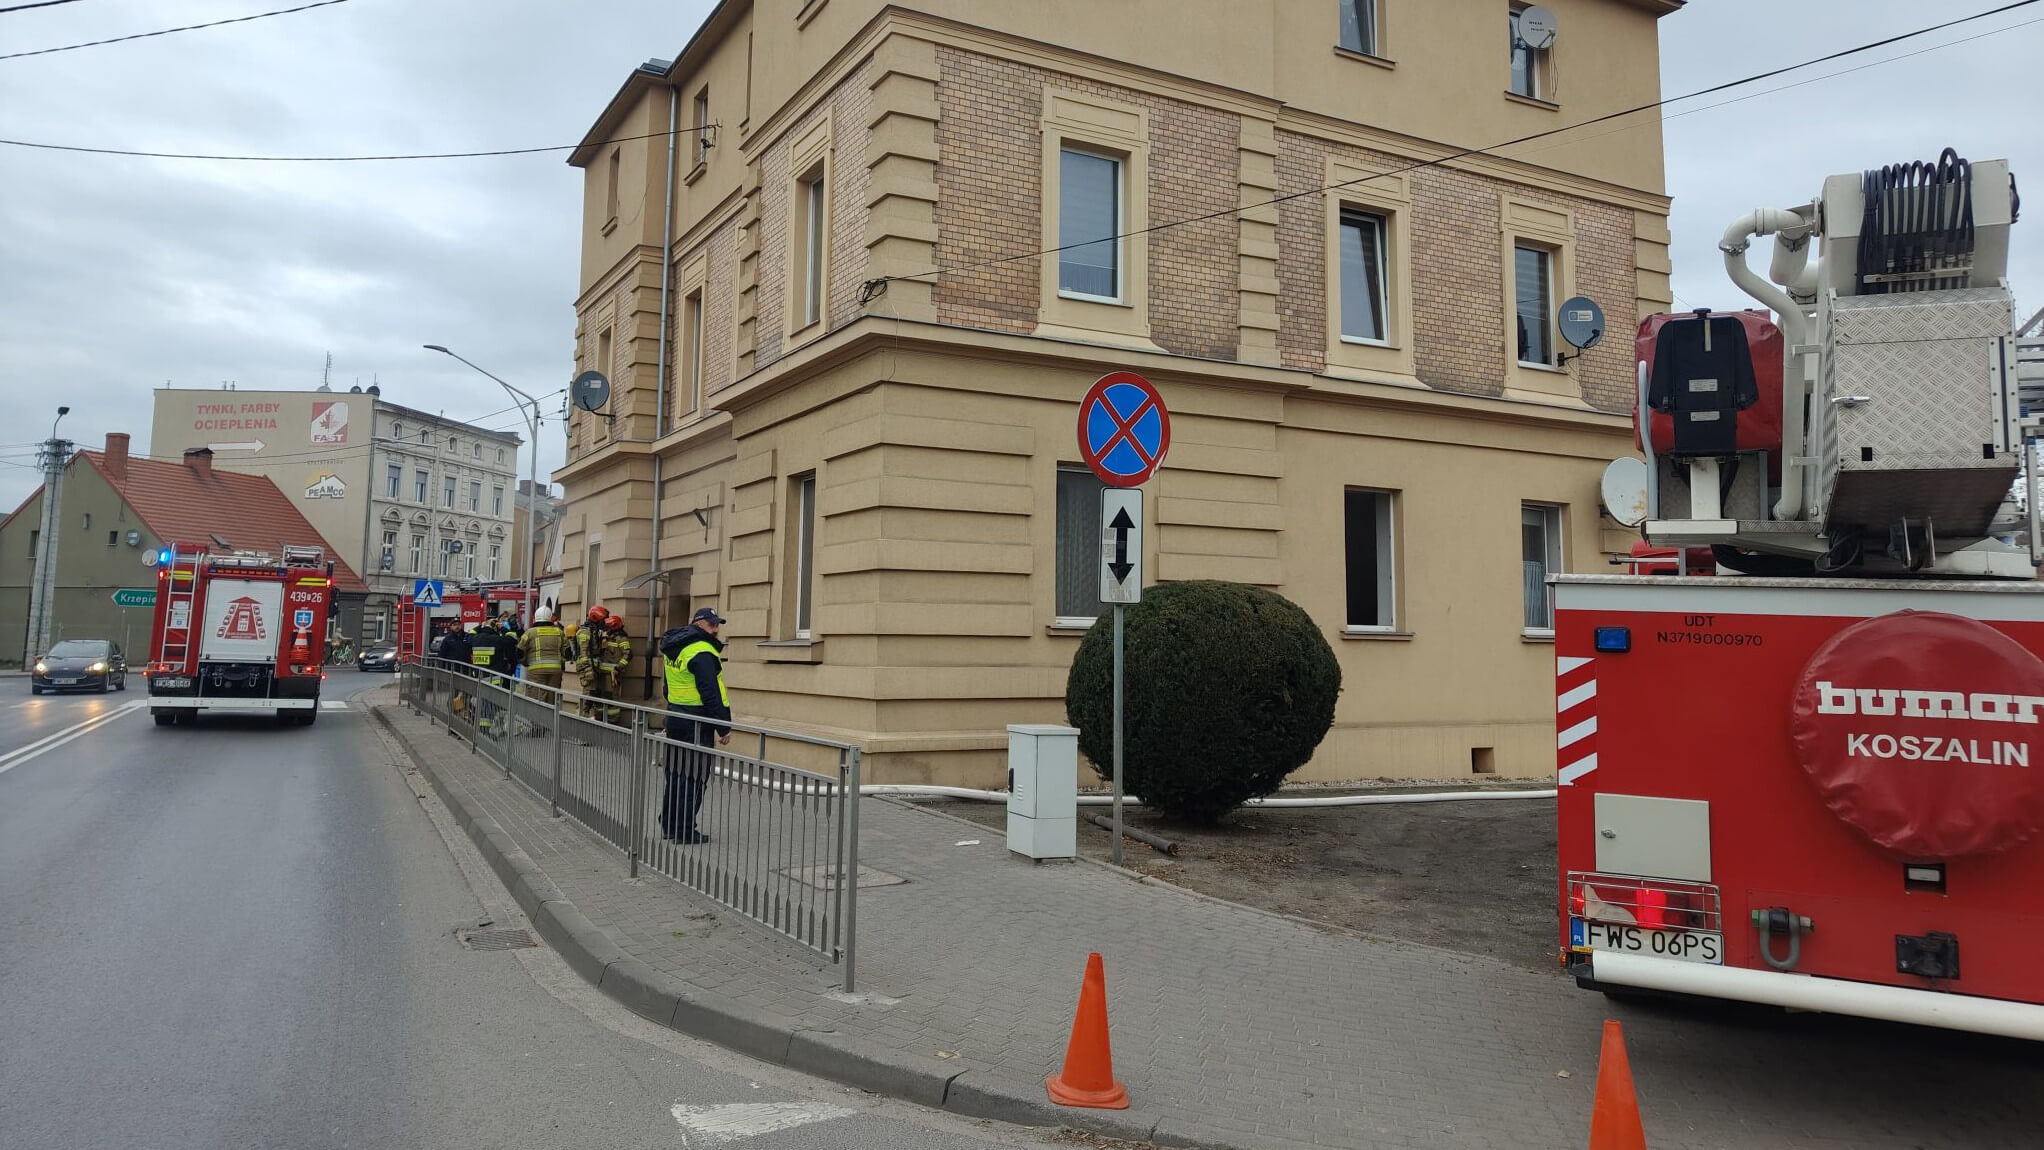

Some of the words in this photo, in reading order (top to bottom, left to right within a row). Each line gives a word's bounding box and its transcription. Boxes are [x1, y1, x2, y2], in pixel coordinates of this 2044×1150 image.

[196, 404, 237, 415] TYNKI,
[241, 403, 280, 414] FARBY
[194, 418, 278, 430] OCIEPLENIA
[313, 433, 345, 442] FAST
[308, 485, 344, 497] PEAMCO
[1684, 615, 1715, 627] UDT
[1657, 631, 1763, 647] N3719000970
[1815, 681, 2044, 723] bumar
[1847, 733, 2029, 767] KOSZALIN
[1588, 920, 1643, 951] FWS
[1651, 931, 1717, 960] 06PS
